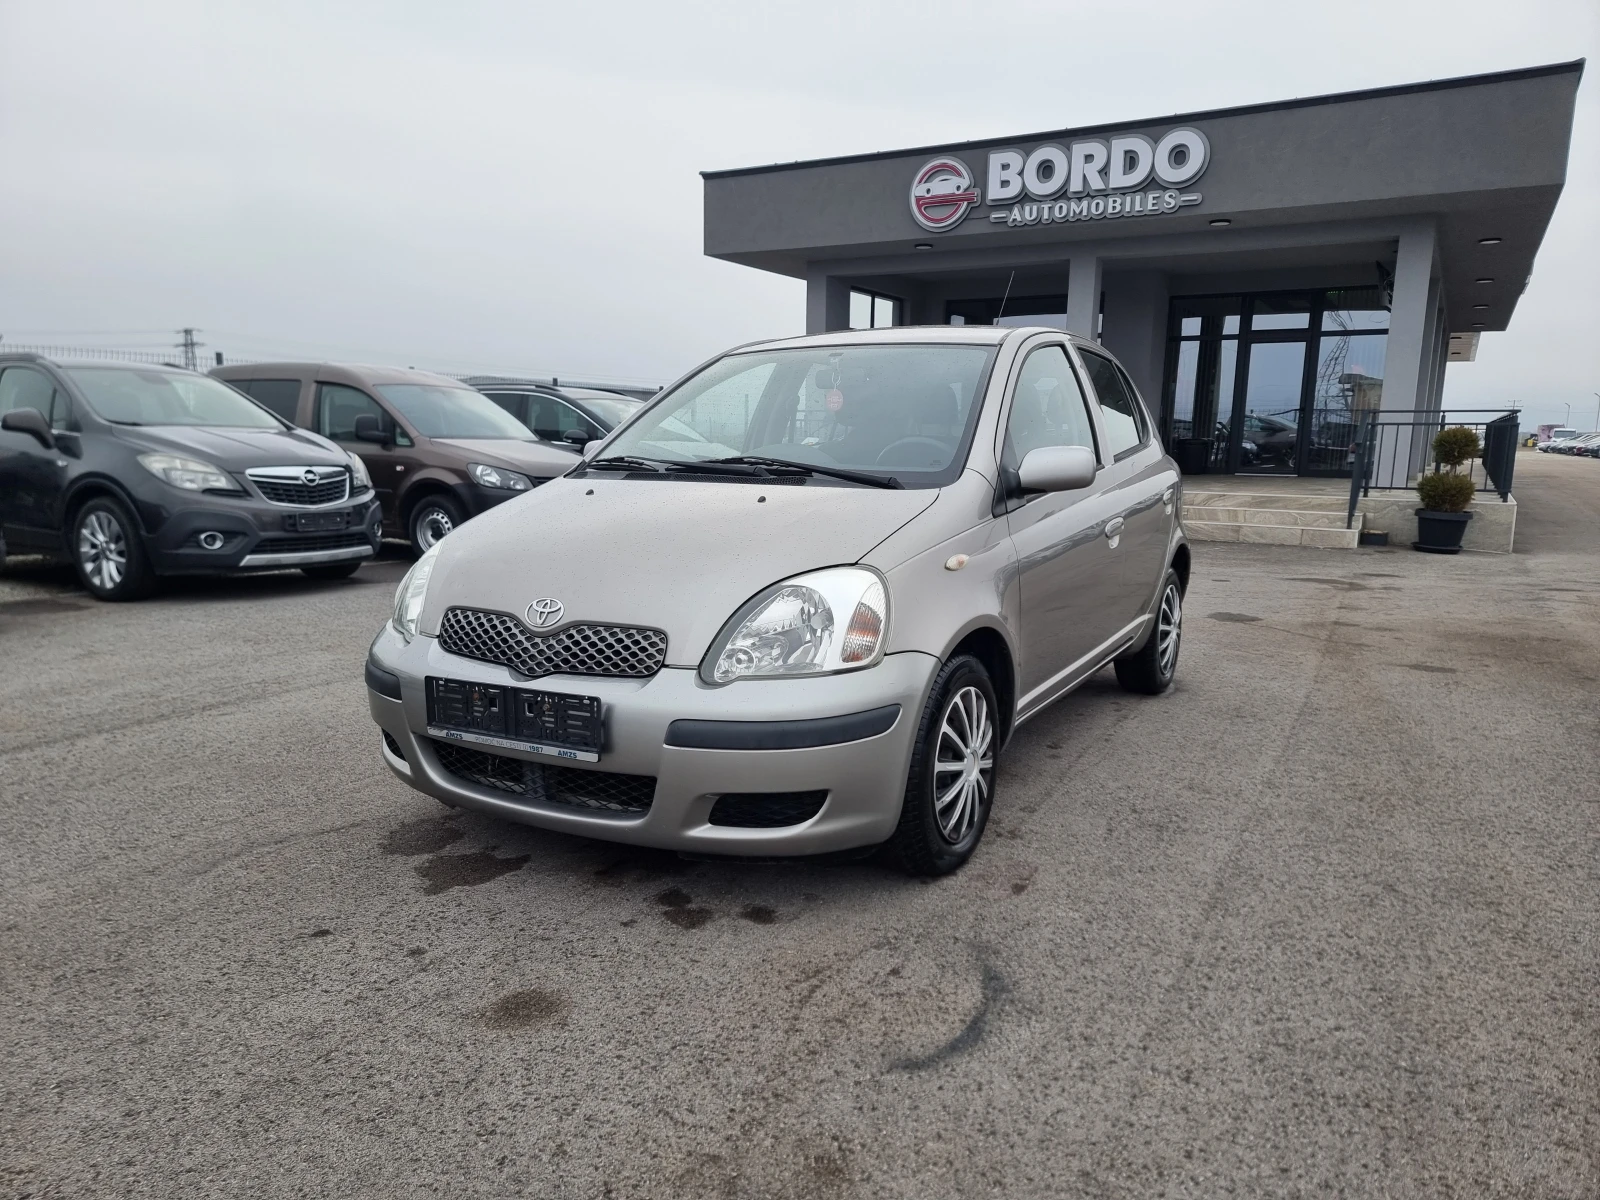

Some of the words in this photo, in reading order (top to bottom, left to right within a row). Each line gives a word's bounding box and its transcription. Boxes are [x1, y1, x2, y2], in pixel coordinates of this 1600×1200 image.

[988, 130, 1206, 201] BORDO
[1009, 192, 1176, 223] AUTOMOBILES
[445, 731, 463, 740] AMZS
[528, 745, 544, 753] 1987
[557, 749, 578, 759] AMZS
